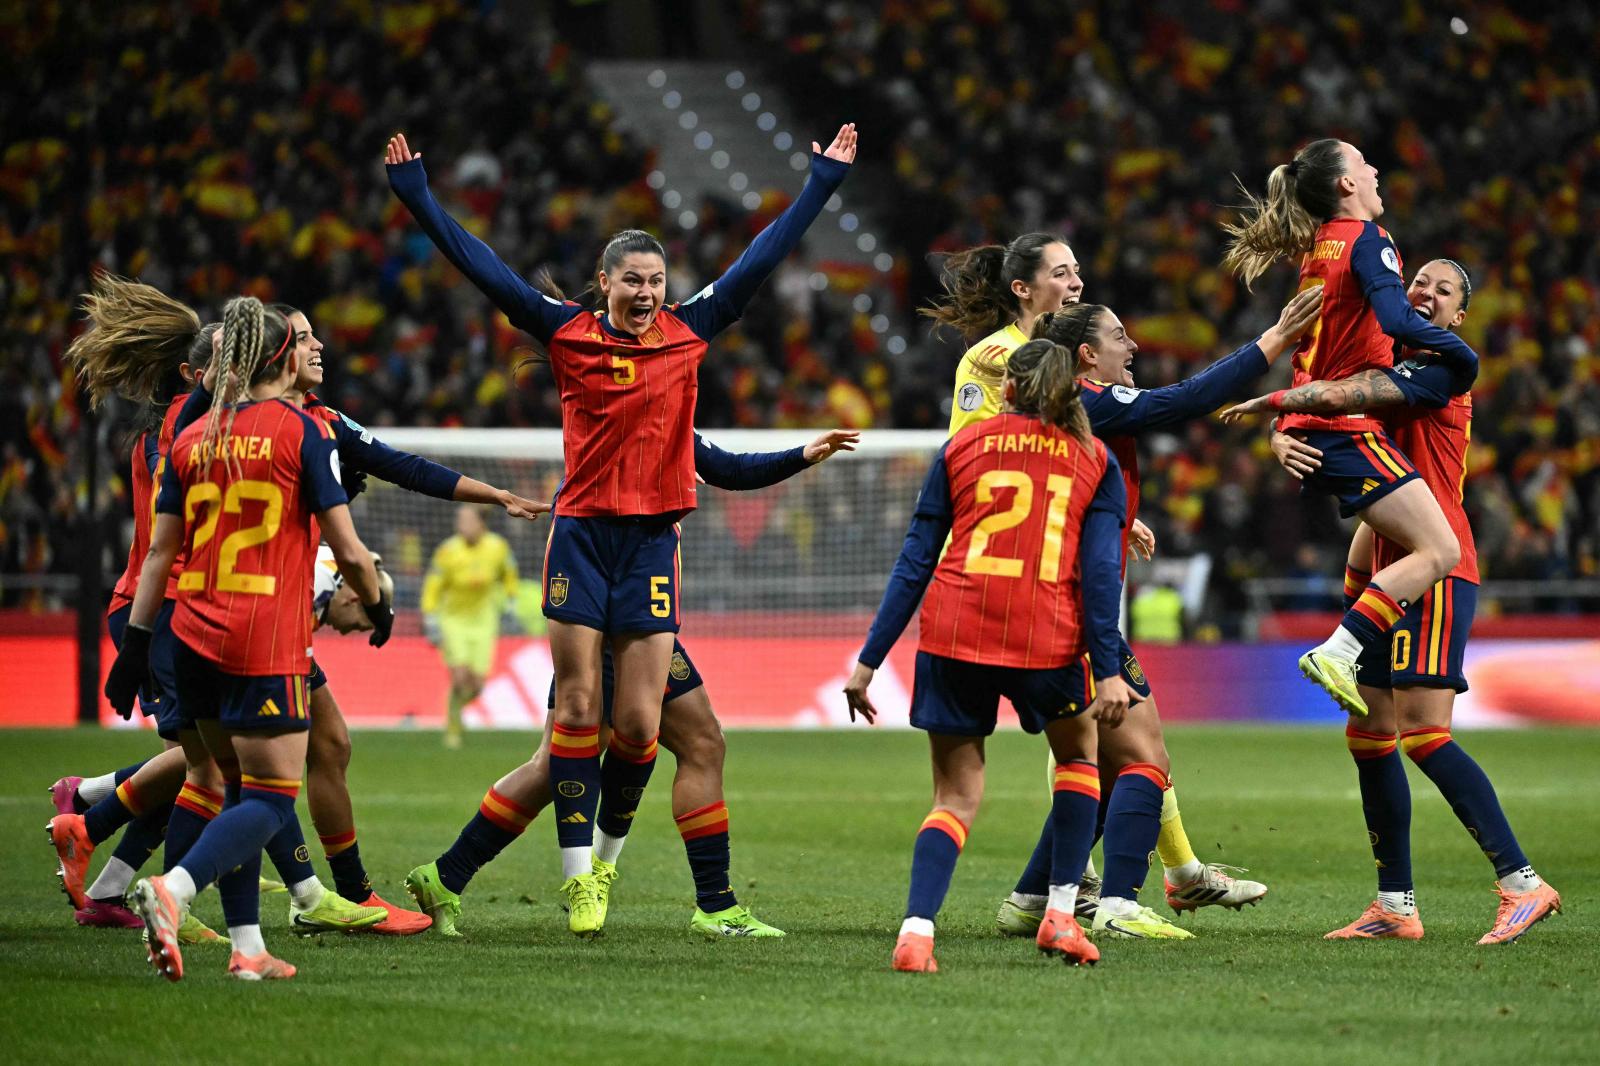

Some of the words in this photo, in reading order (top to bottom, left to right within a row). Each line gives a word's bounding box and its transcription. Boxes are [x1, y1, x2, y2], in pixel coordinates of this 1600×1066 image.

[612, 348, 636, 385] 5
[983, 433, 1069, 458] FIAMMA
[177, 479, 283, 596] 22
[964, 470, 1073, 583] 21
[650, 576, 671, 618] 5
[1392, 629, 1411, 671] 0
